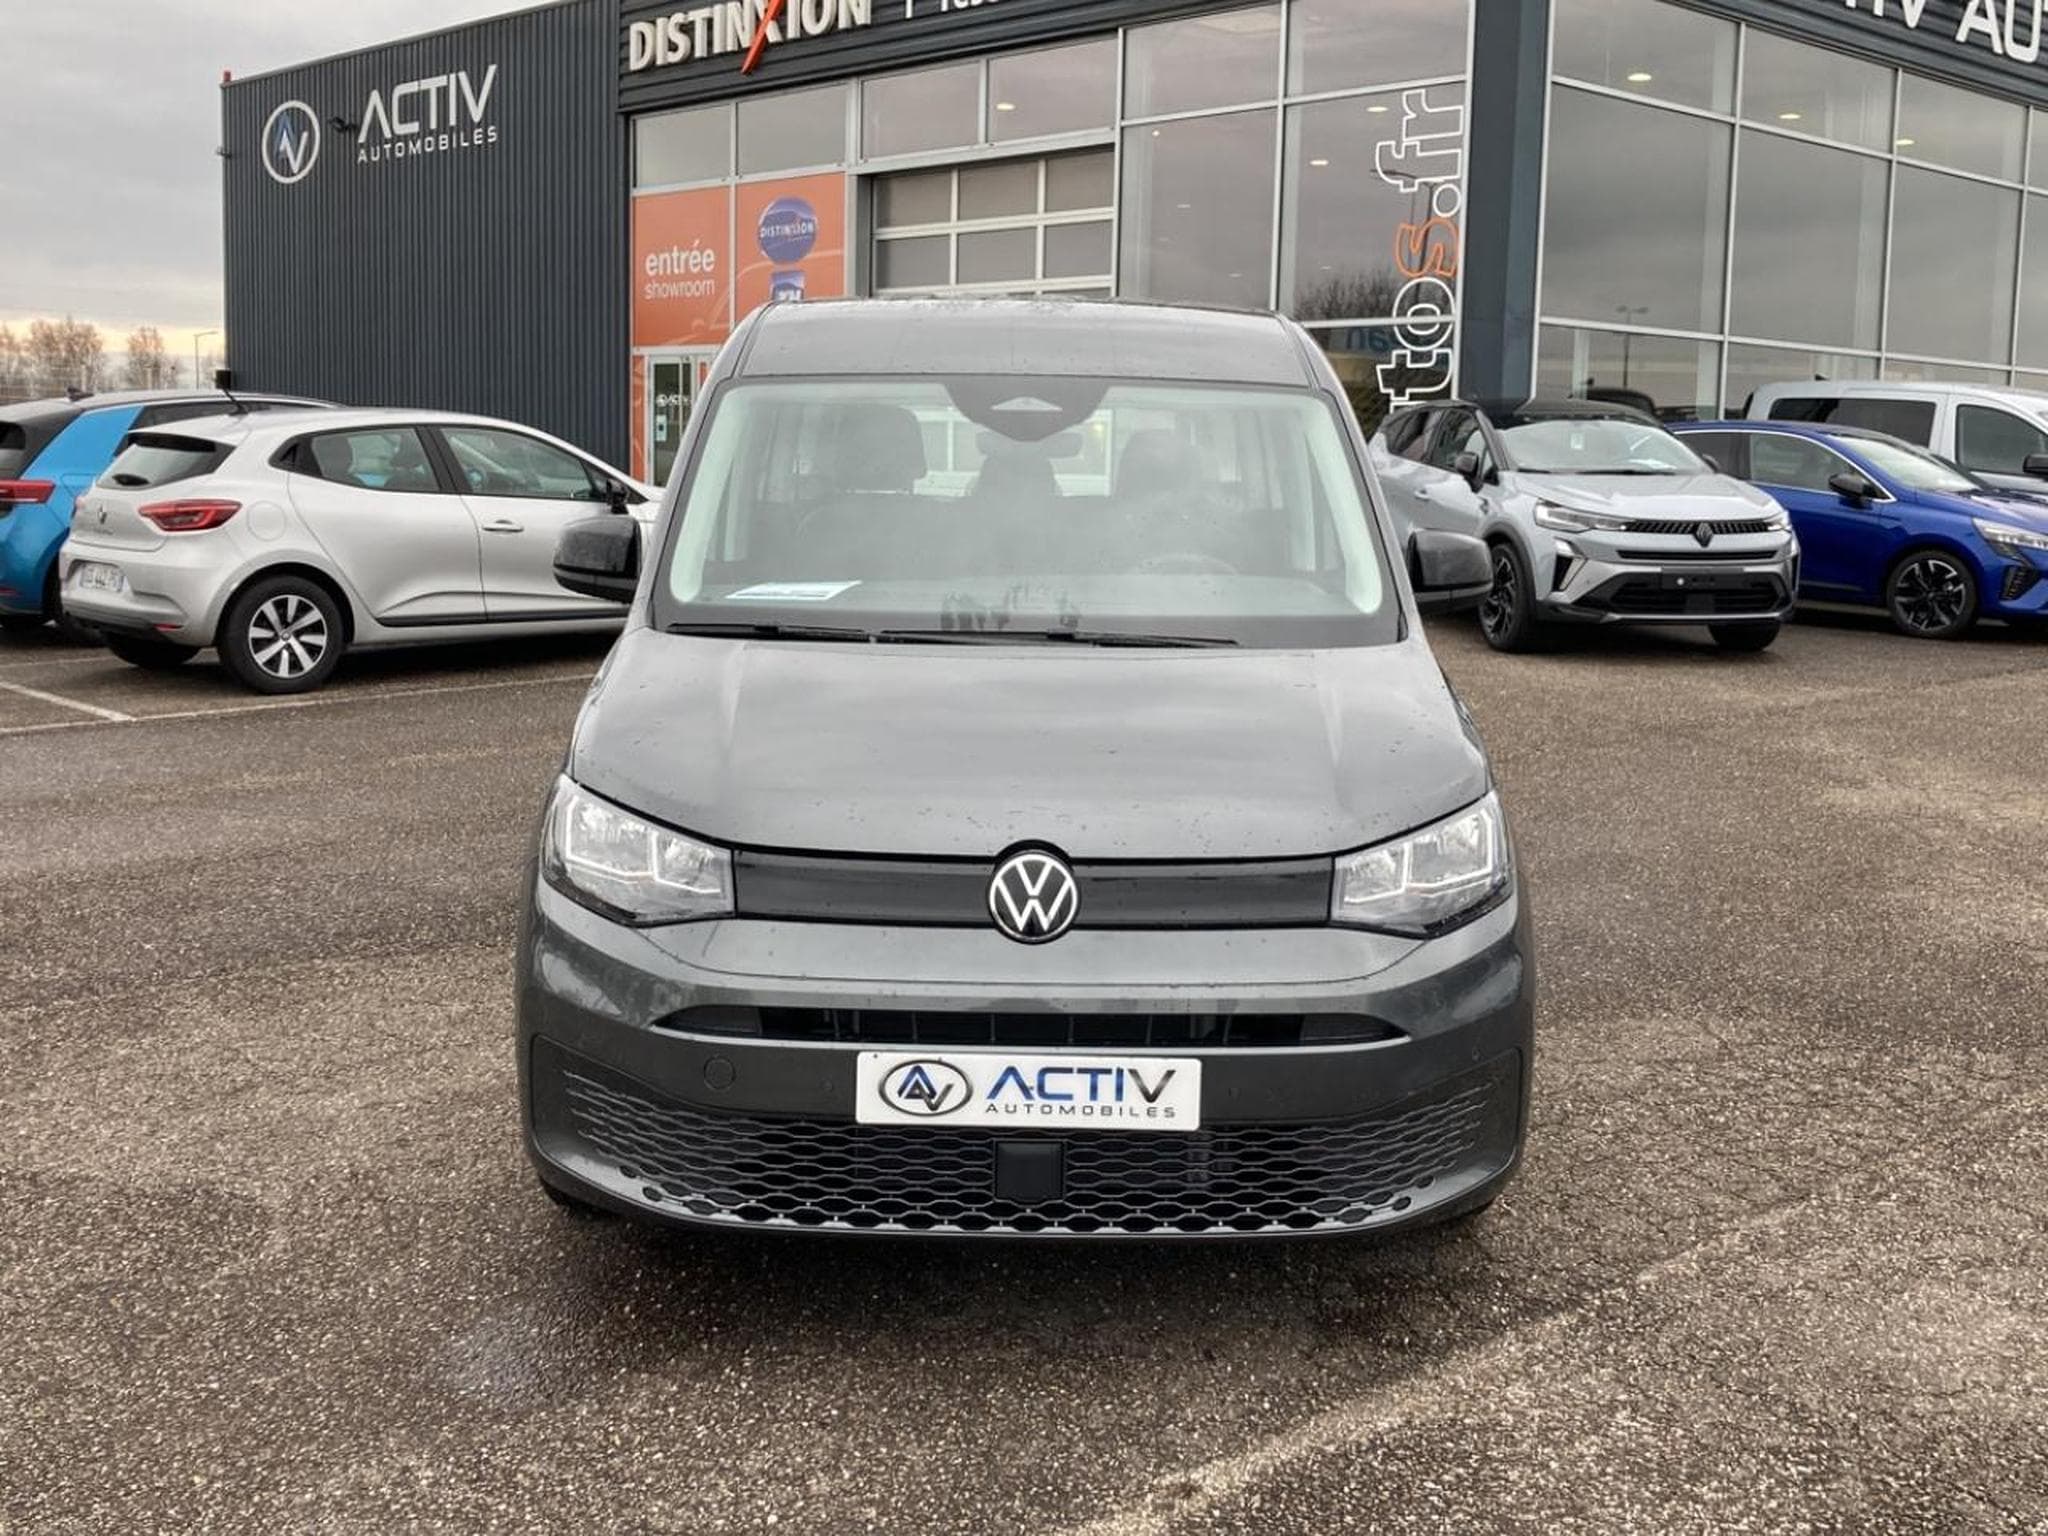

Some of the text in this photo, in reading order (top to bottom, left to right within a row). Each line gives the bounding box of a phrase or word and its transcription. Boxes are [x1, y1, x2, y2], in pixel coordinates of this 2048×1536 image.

[1955, 0, 2048, 63] AU
[357, 63, 498, 144] ACTIV
[357, 125, 498, 164] AUTOMOBILES
[645, 239, 716, 277] entrée
[1375, 88, 1464, 413] tos.fr
[644, 280, 716, 300] showroom
[986, 1065, 1177, 1103] ACTIV
[985, 1103, 1177, 1119] AUTOMOBILES
